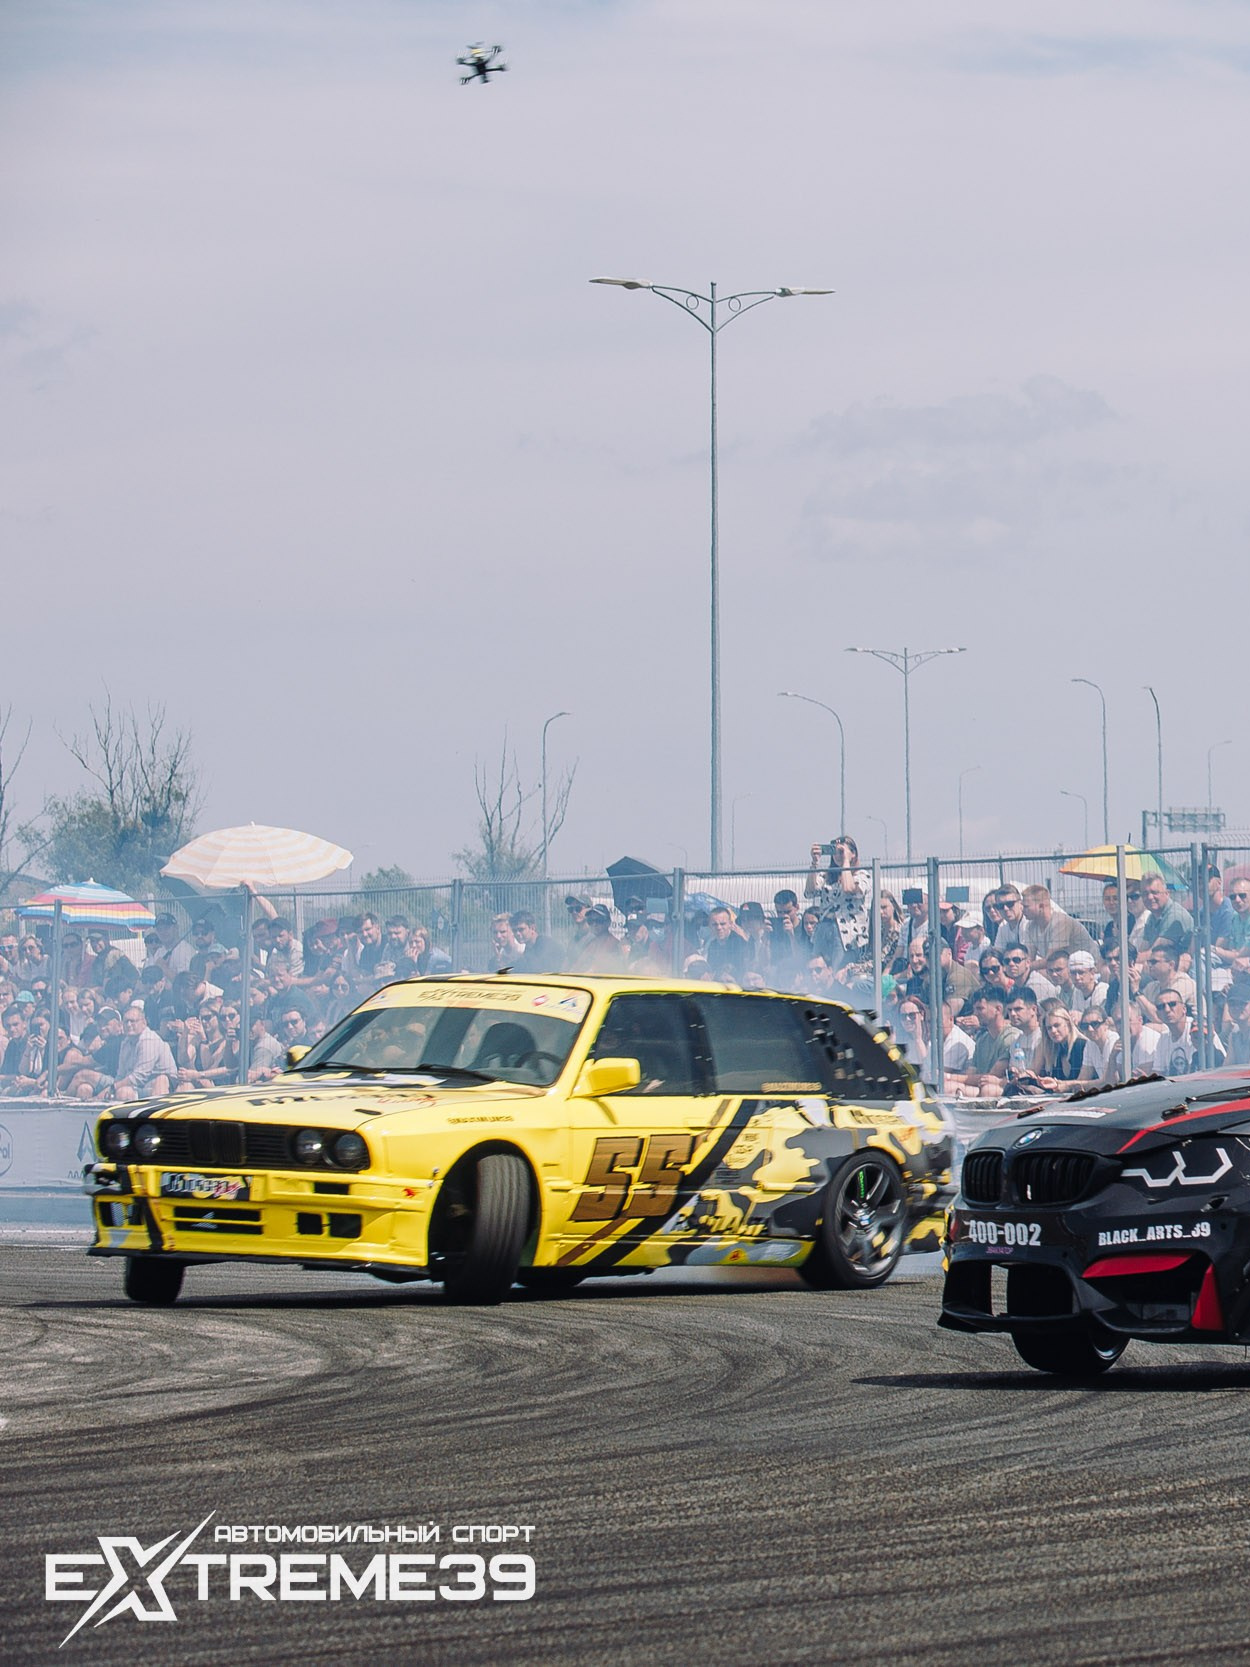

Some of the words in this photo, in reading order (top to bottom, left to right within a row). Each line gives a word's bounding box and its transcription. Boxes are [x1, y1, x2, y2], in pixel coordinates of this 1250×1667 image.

[568, 1134, 692, 1222] 55
[968, 1219, 1042, 1246] 400-002
[1098, 1221, 1212, 1246] BLACK_ARTS_39
